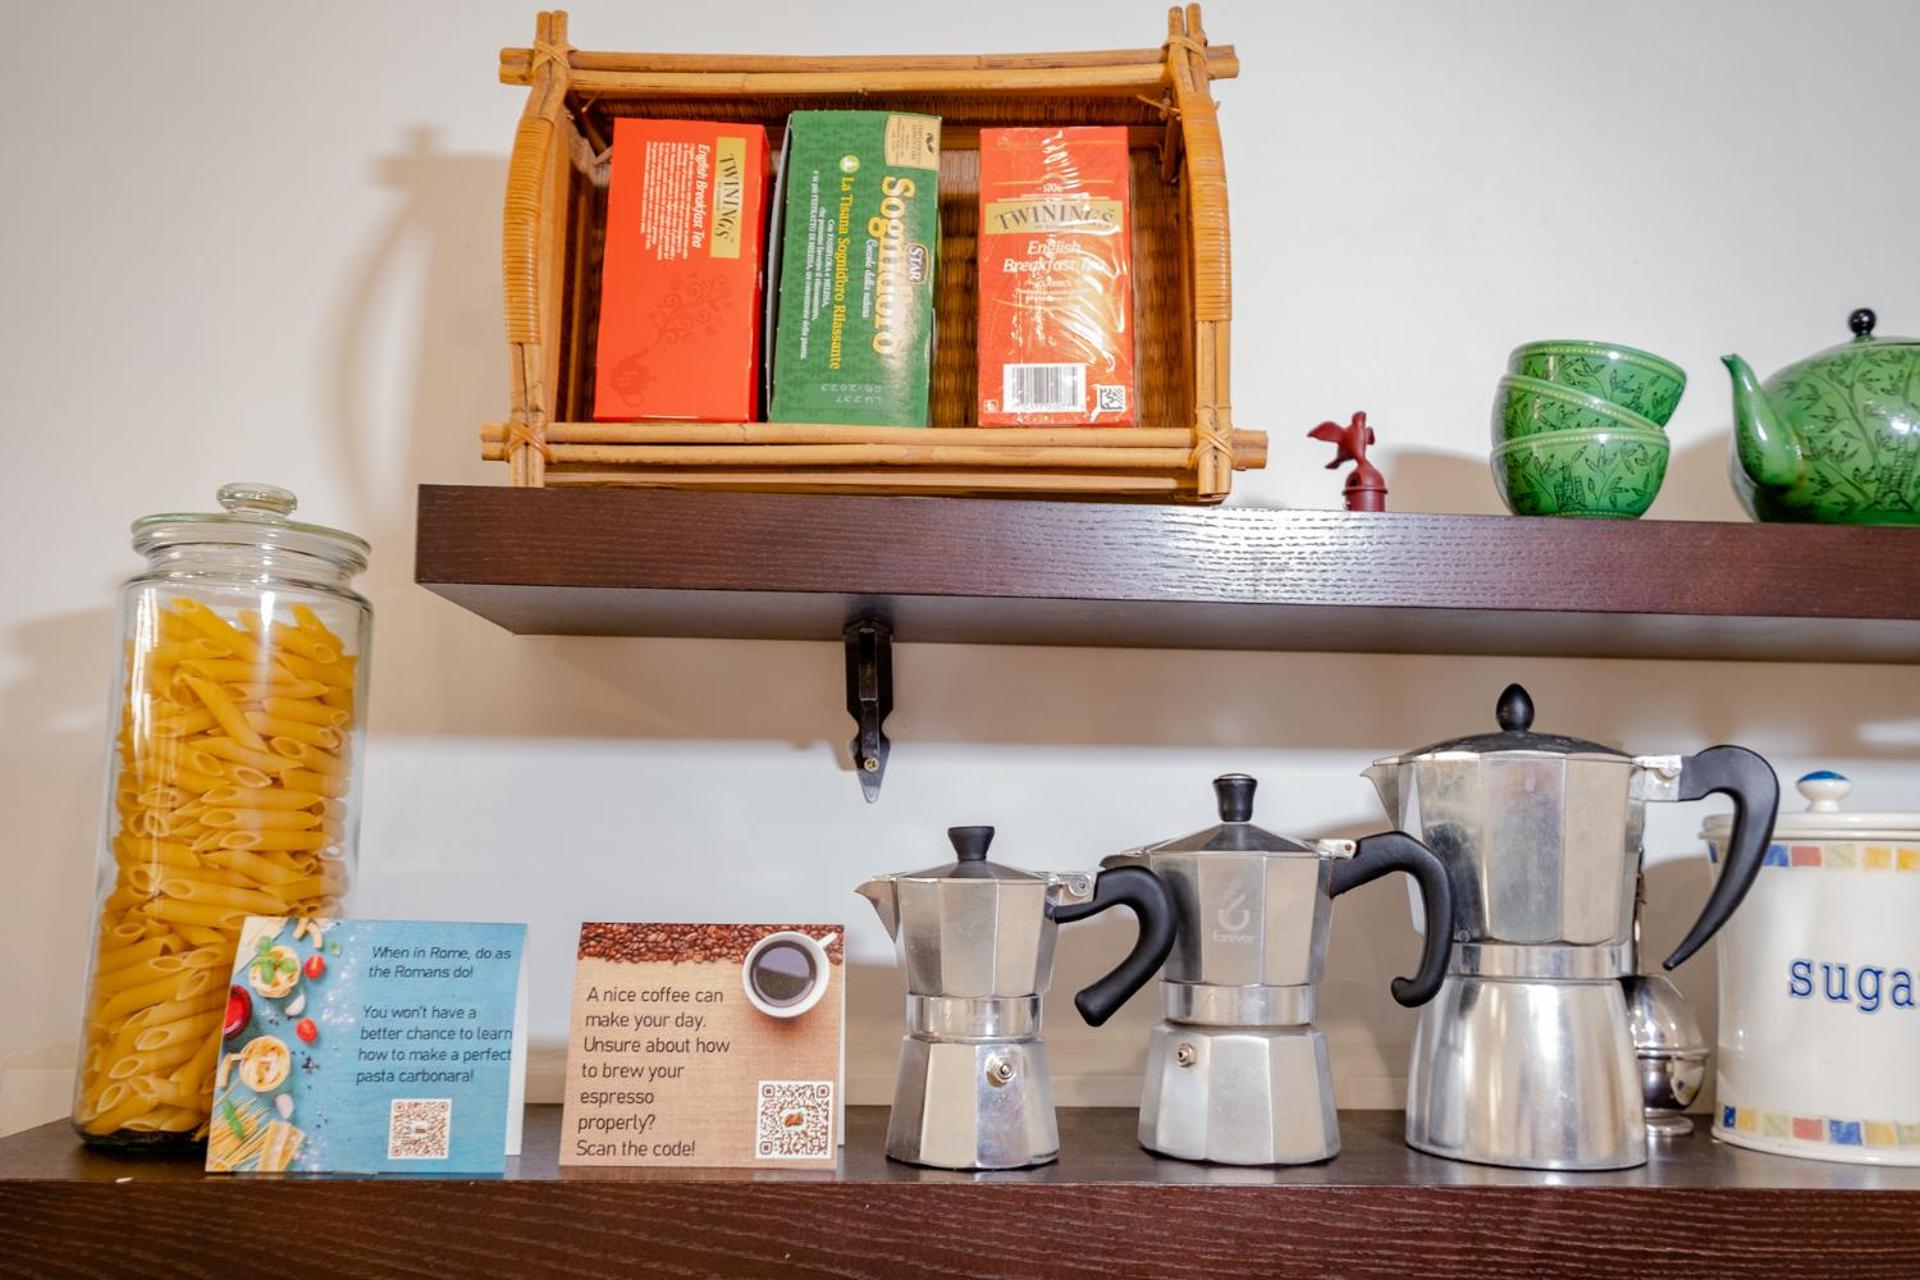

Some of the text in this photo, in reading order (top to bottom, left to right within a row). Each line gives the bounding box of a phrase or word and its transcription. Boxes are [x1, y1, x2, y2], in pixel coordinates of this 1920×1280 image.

[840, 176, 854, 192] La
[691, 143, 710, 249] English Breakfast Tea
[715, 153, 740, 239] TWININGS
[838, 194, 854, 234] Tisana
[995, 204, 1116, 230] TWININGS
[1027, 240, 1082, 259] English
[908, 247, 924, 281] STAR
[863, 269, 875, 291] dalla
[830, 304, 846, 369] Rilassante
[372, 946, 512, 962] When in Rome, do as
[369, 966, 473, 979] the Romans do!
[586, 987, 724, 1003] A nice coffee can
[1789, 958, 1917, 1013] suga
[363, 1006, 477, 1019] You won't have a
[585, 1013, 707, 1032] make your day.
[360, 1027, 512, 1041] better chance to learn
[583, 1037, 731, 1053] Unsure about how
[358, 1048, 512, 1064] how to make a perfect
[355, 1069, 474, 1086] pasta carbonara!
[582, 1063, 685, 1082] to brew your
[580, 1092, 655, 1108] espresso
[578, 1115, 656, 1135] properly?
[575, 1140, 696, 1157] Scan the code!
